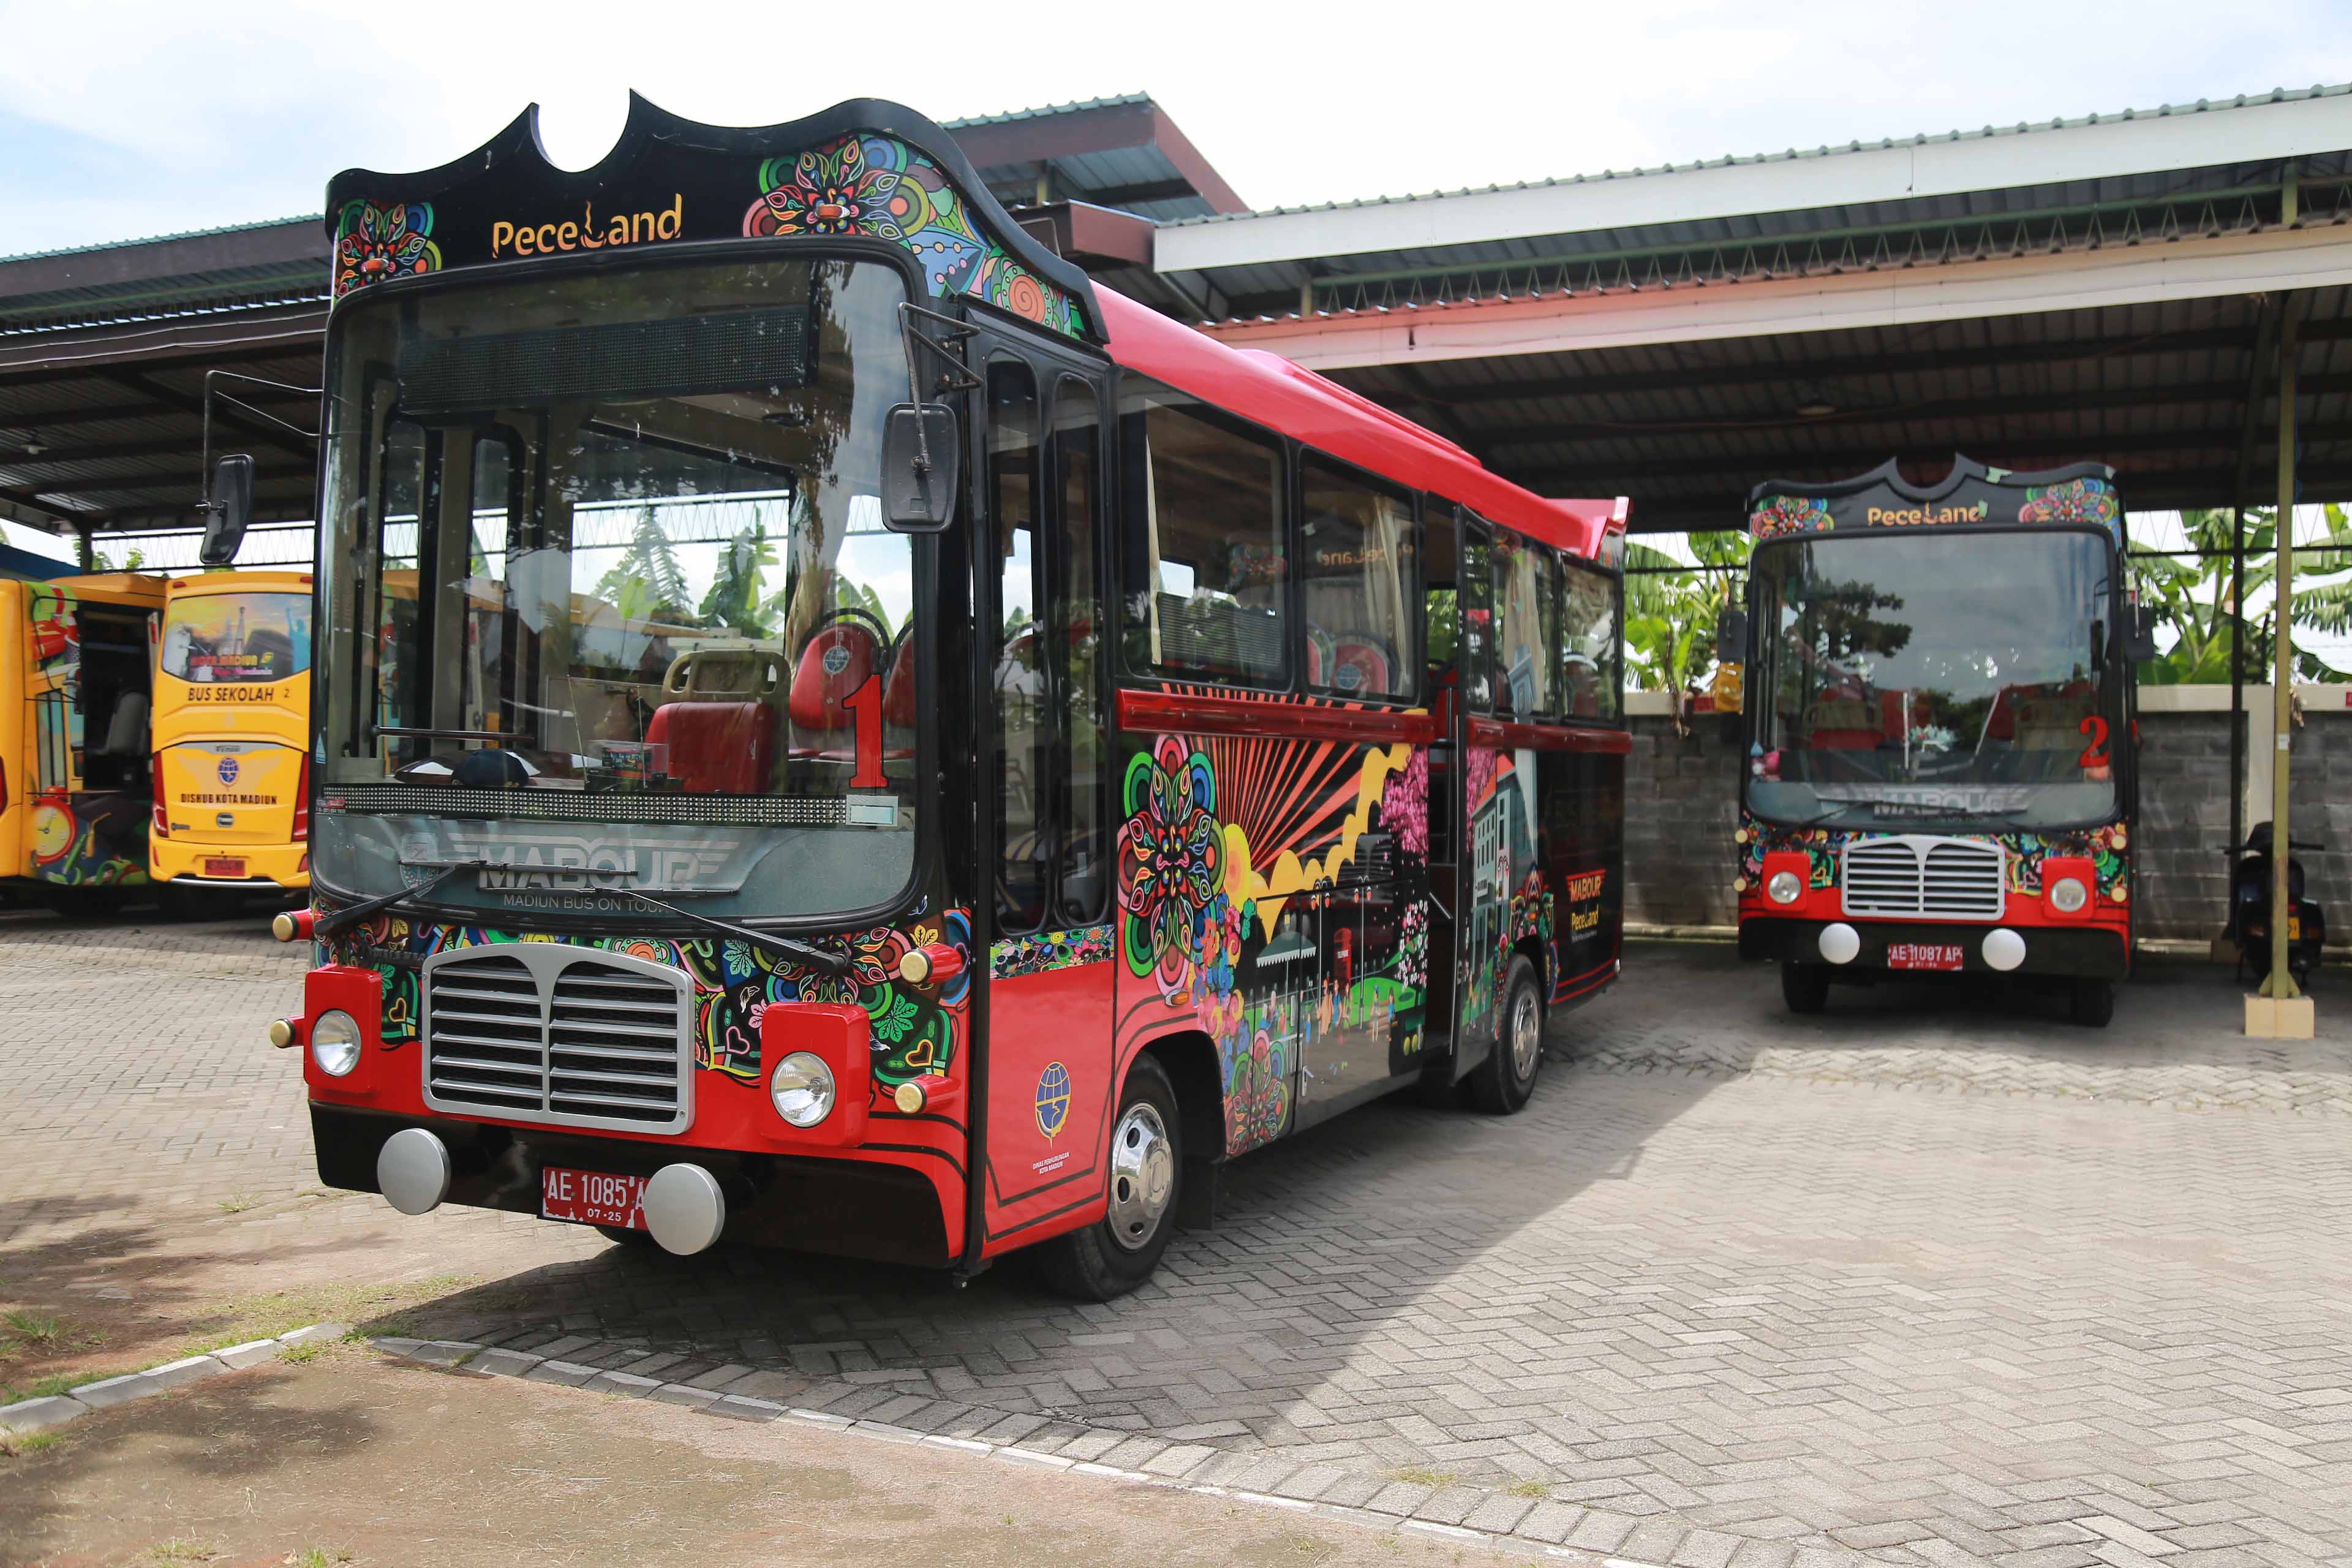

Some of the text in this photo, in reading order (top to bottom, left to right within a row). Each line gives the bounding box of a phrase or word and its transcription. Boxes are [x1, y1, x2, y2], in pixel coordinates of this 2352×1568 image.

[188, 687, 290, 701] BUS SEKOLAH 2
[842, 673, 888, 788] 1
[2079, 715, 2111, 768] 2
[181, 793, 277, 804] DISHUB KOTA MADIUN
[1570, 875, 1601, 902] MABOUR
[504, 894, 559, 908] MADIUN
[563, 897, 594, 910] BUS
[598, 898, 622, 911] ON
[1891, 945, 1907, 961] AE
[548, 1170, 571, 1201] AE
[581, 1174, 627, 1208] 1085
